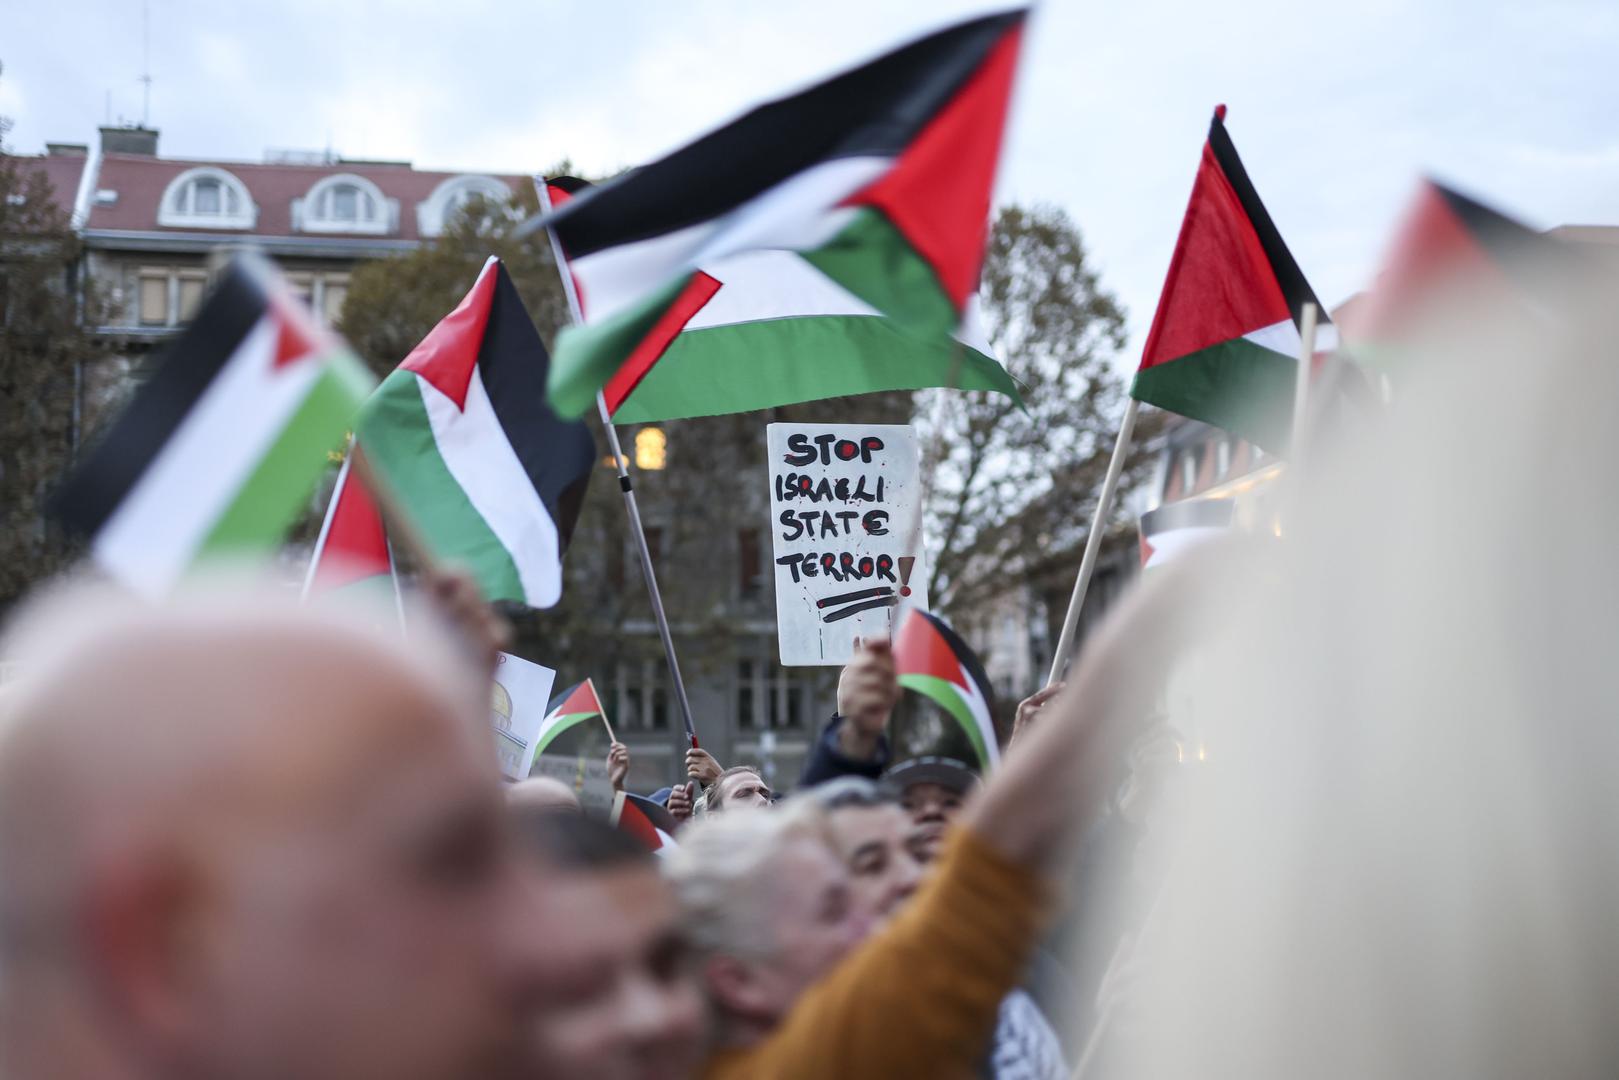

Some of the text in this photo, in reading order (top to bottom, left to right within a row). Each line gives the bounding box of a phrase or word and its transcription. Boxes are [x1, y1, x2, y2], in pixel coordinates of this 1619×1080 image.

[784, 434, 884, 467] STOP
[776, 473, 884, 502] ISRAELI
[780, 510, 889, 541] STATE
